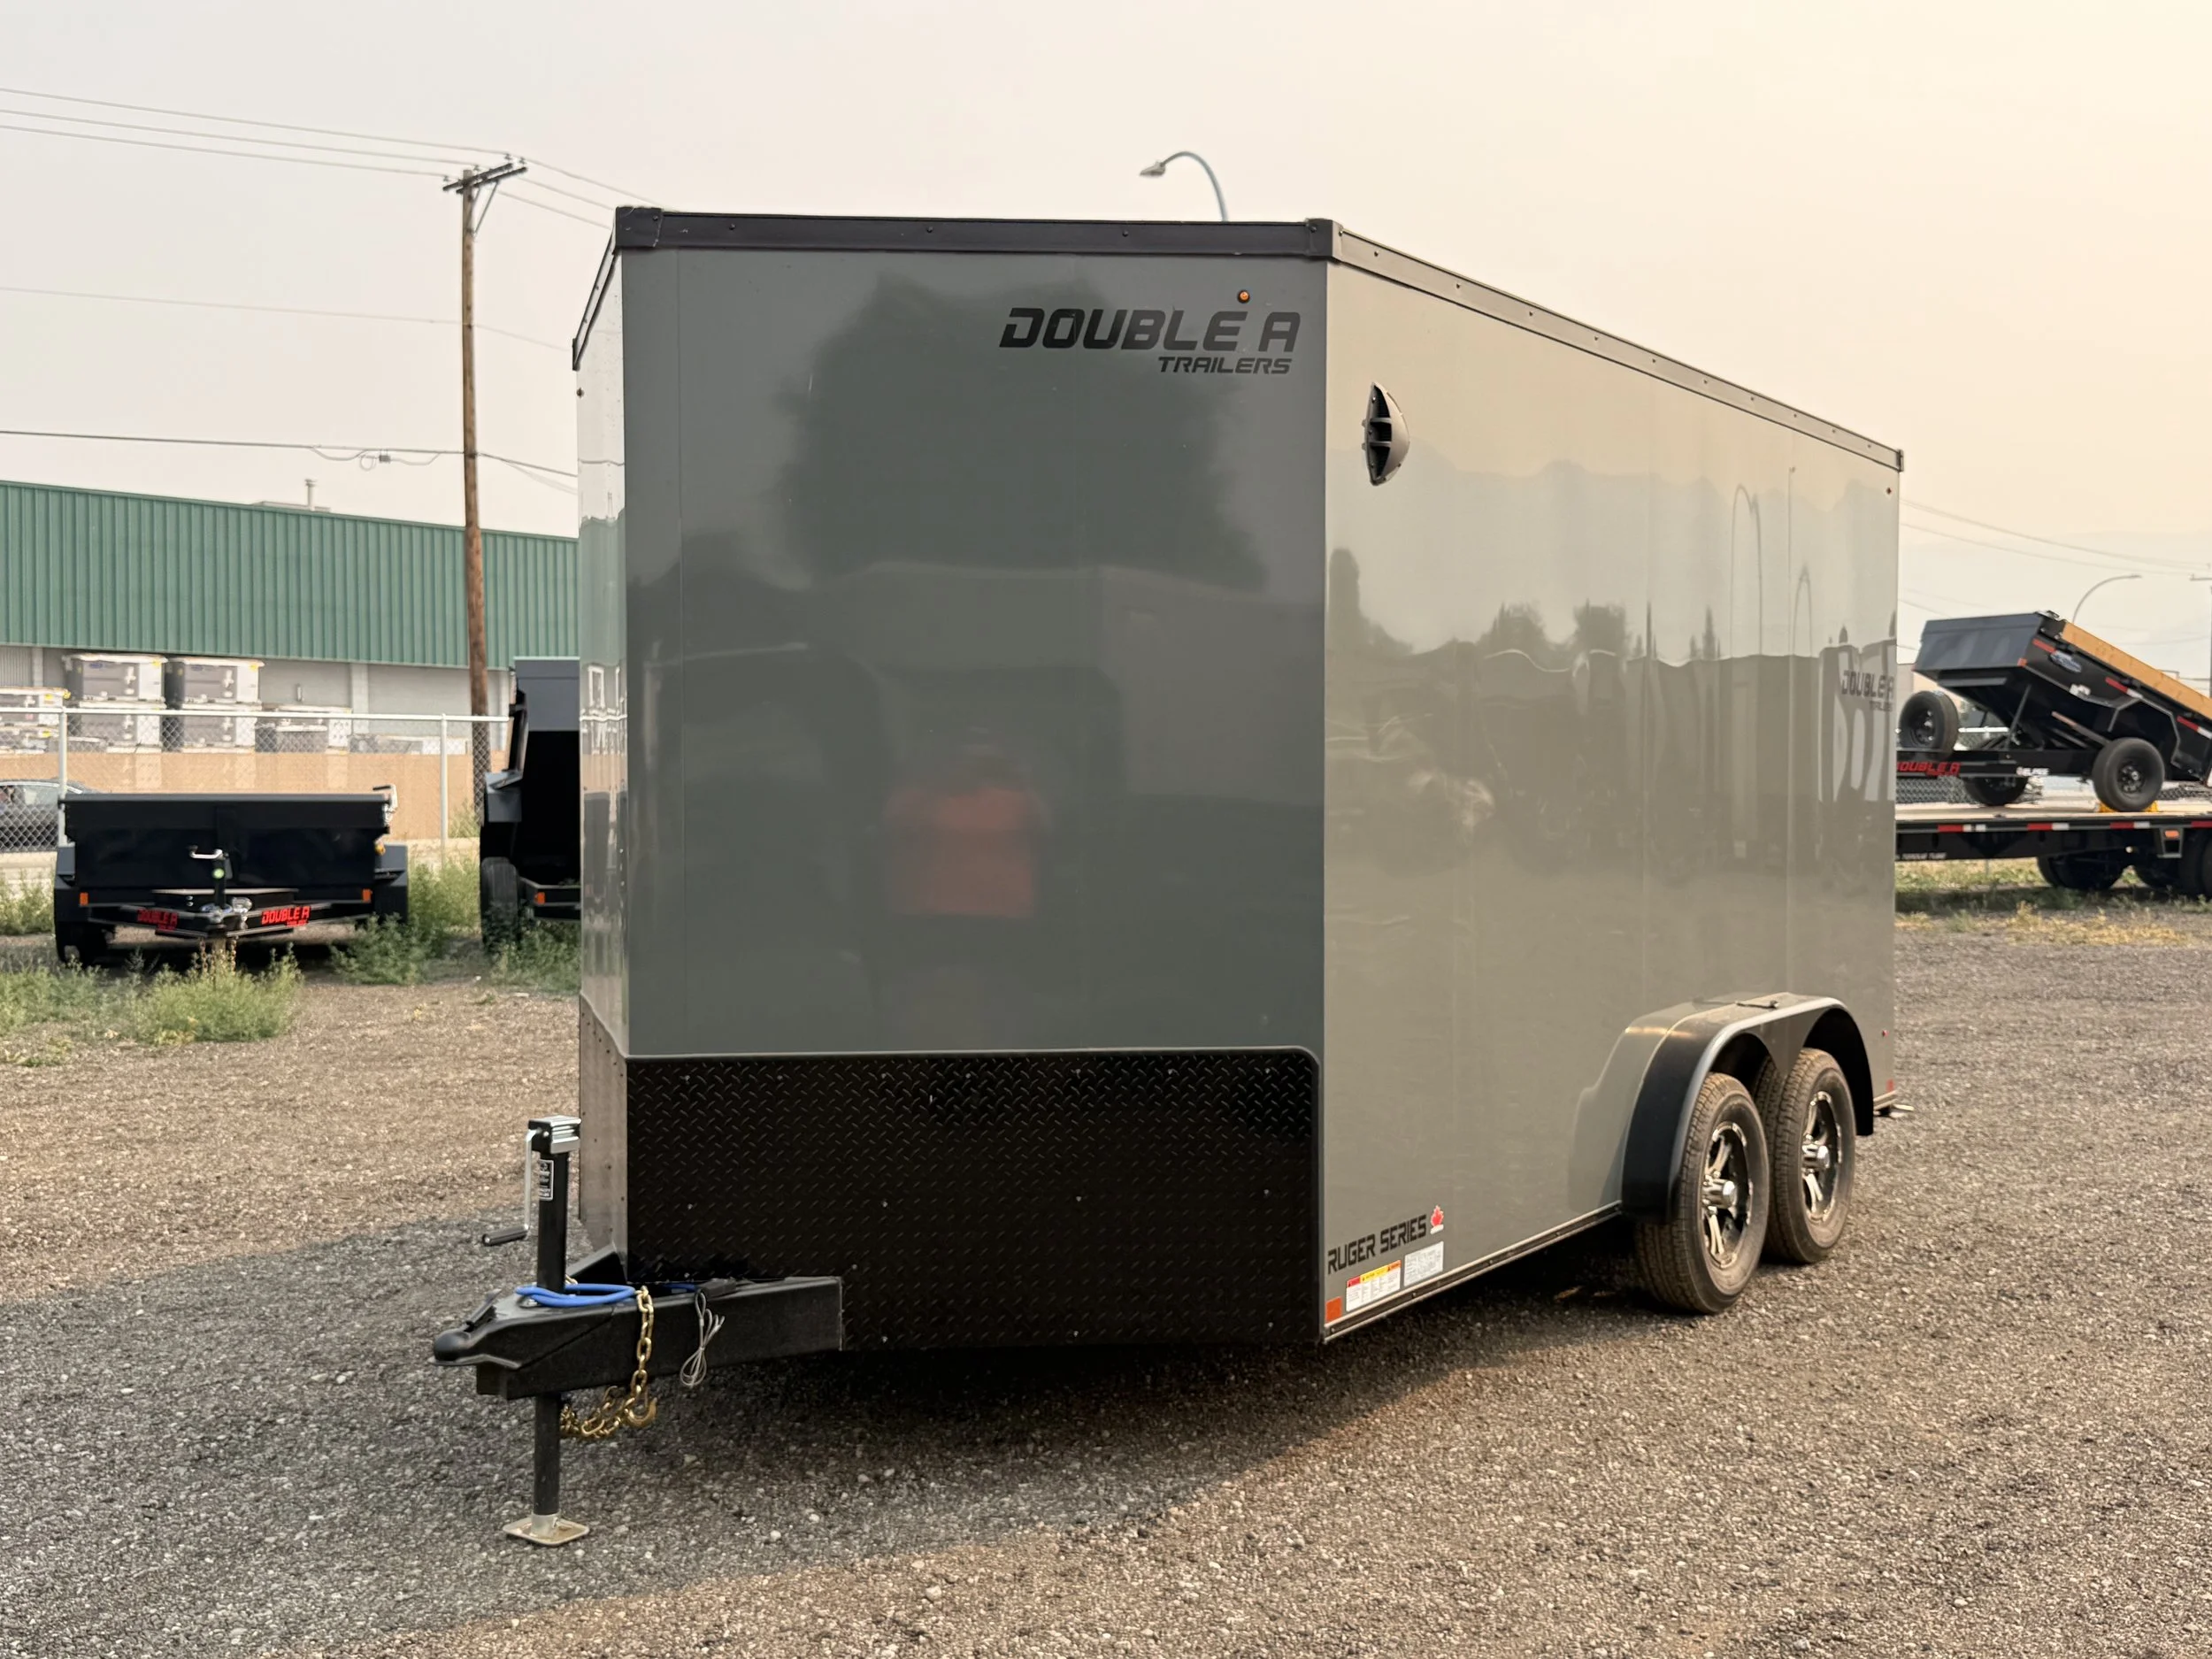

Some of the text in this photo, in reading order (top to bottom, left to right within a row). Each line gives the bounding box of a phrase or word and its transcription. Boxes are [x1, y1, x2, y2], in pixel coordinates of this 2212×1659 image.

[999, 307, 1302, 352] DOUBLE A
[1158, 356, 1293, 374] TRAILERS
[1841, 670, 1886, 698] DOUBLE
[261, 907, 301, 926] DOUBLE
[301, 905, 311, 920] A
[1327, 1233, 1375, 1274] RUGER
[1379, 1214, 1427, 1255] SERIES
